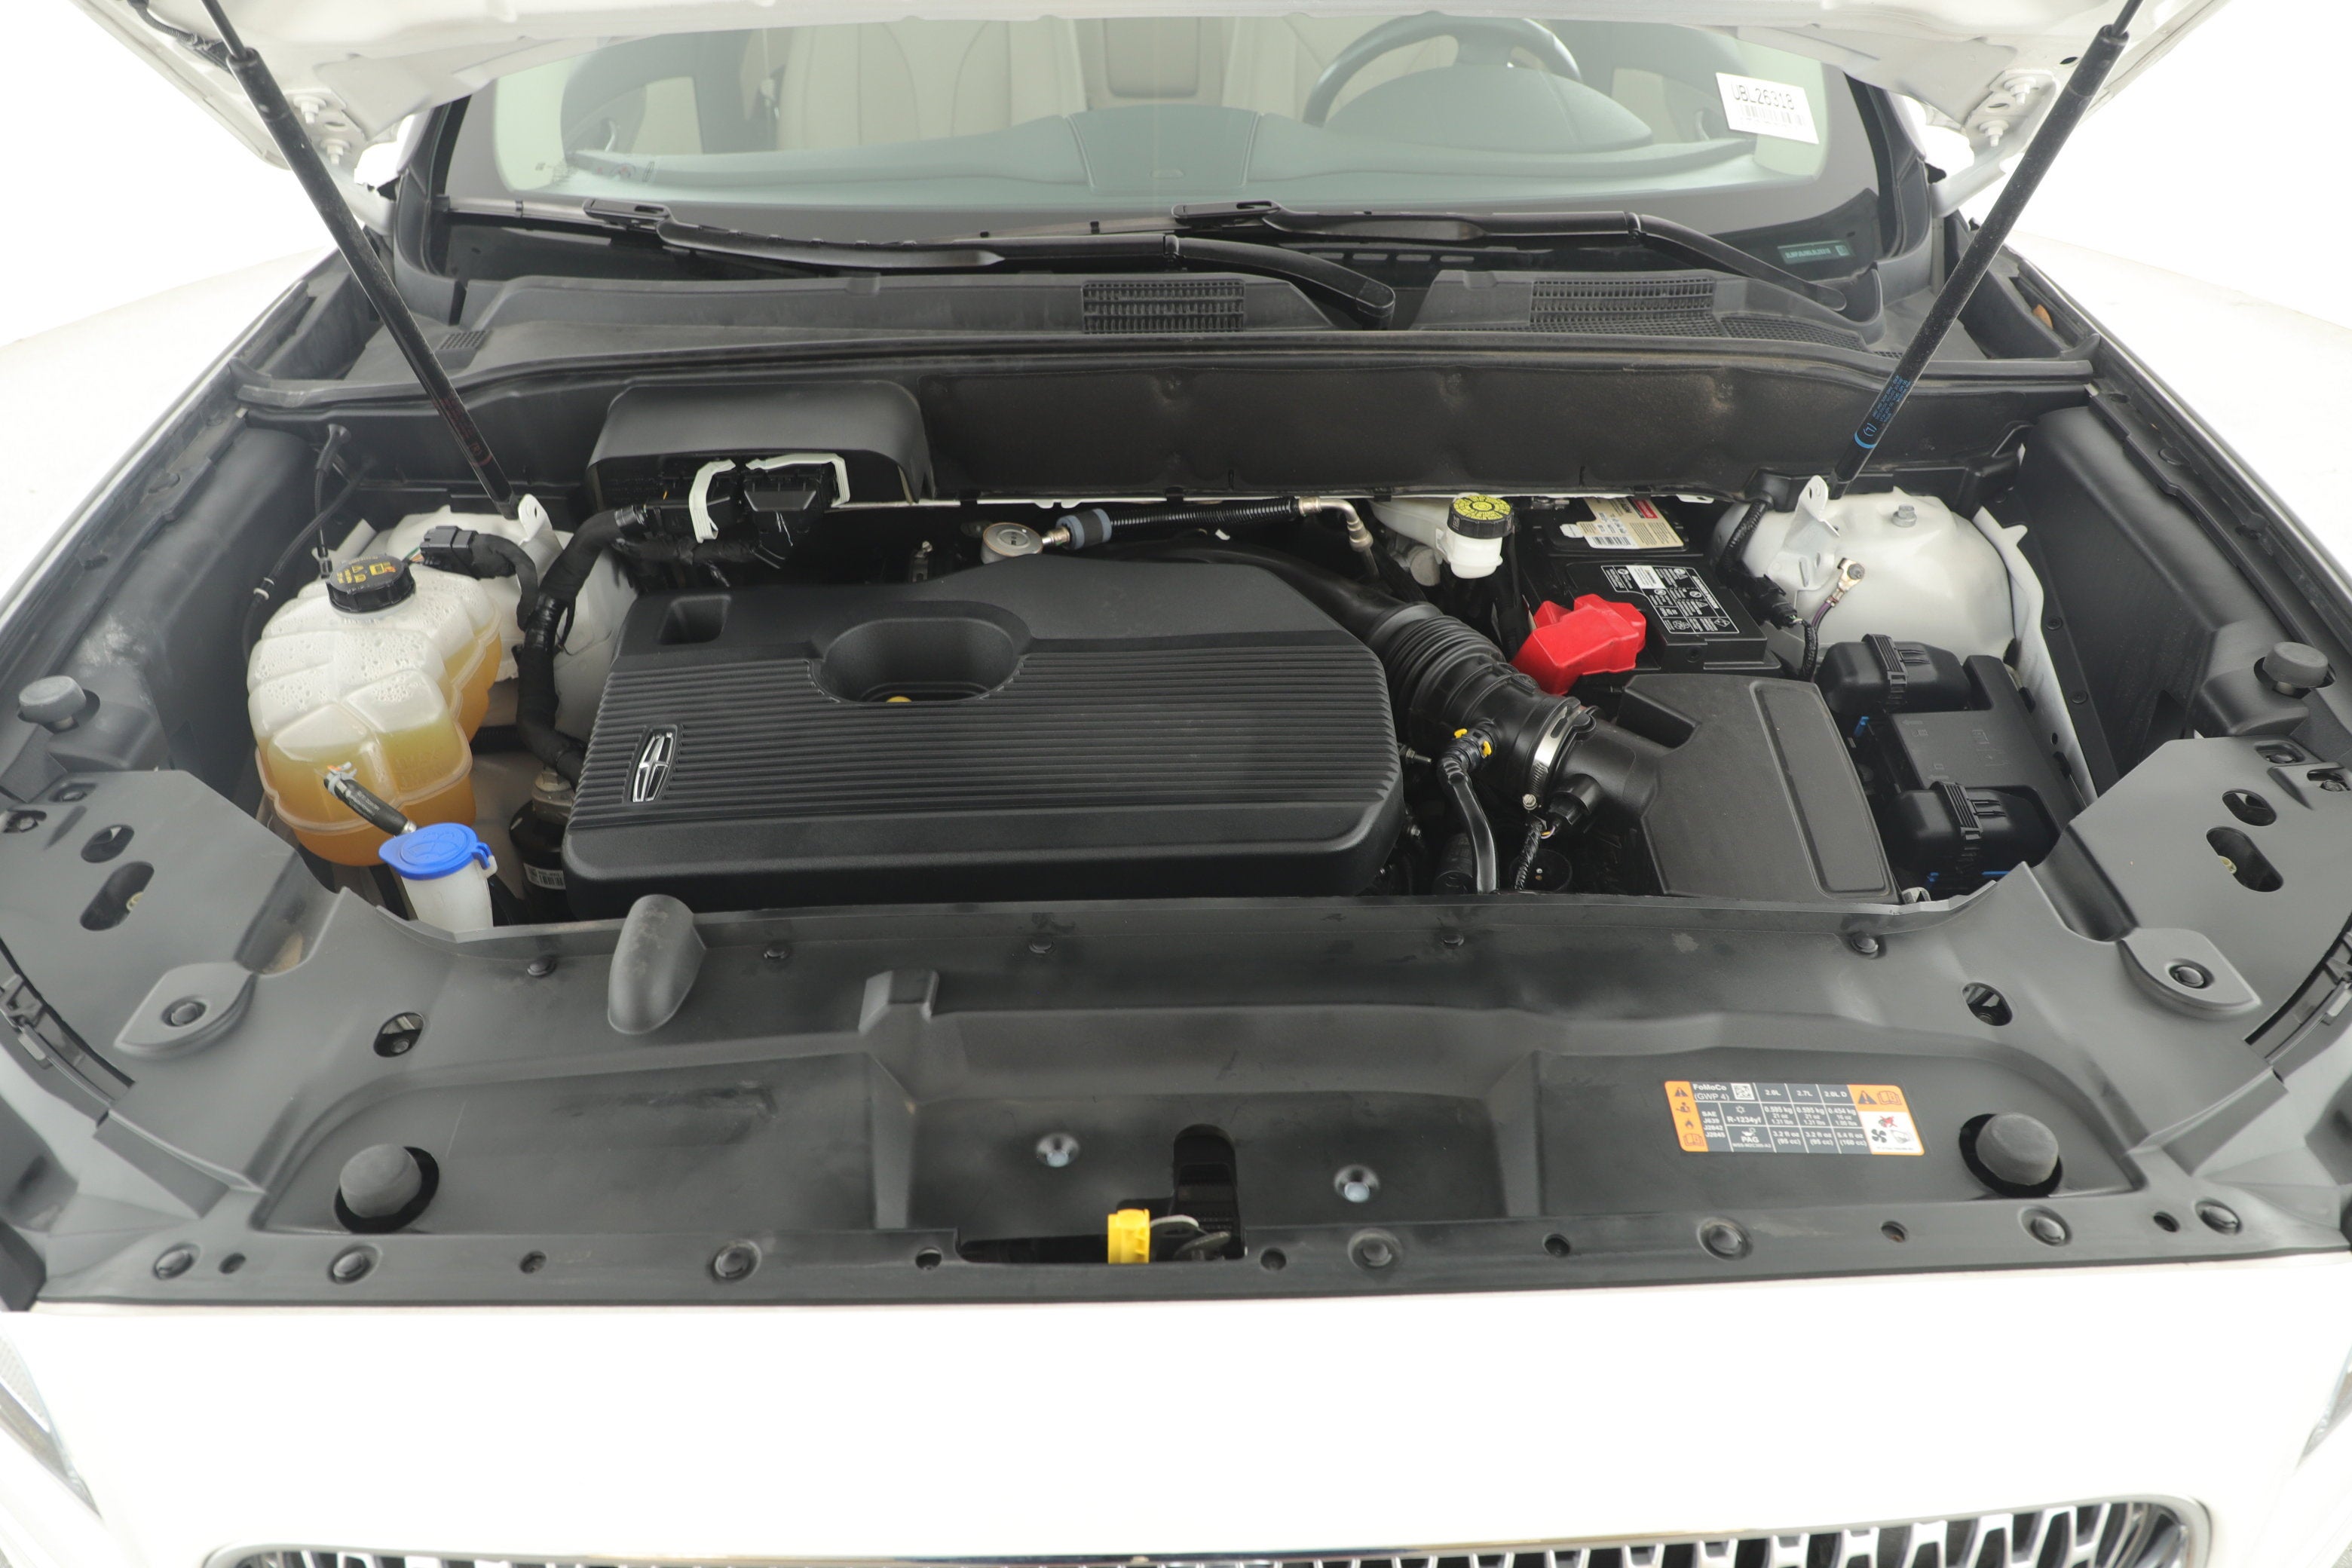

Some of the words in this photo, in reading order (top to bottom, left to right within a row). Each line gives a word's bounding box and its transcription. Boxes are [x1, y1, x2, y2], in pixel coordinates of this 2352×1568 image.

[1731, 84, 1794, 110] UBL26318
[1695, 1092, 1720, 1101] (GWP
[1720, 1093, 1730, 1101] 4)
[1783, 1107, 1793, 1115] kg
[1815, 1107, 1825, 1116] kg
[1726, 1116, 1762, 1125] R-1234yf
